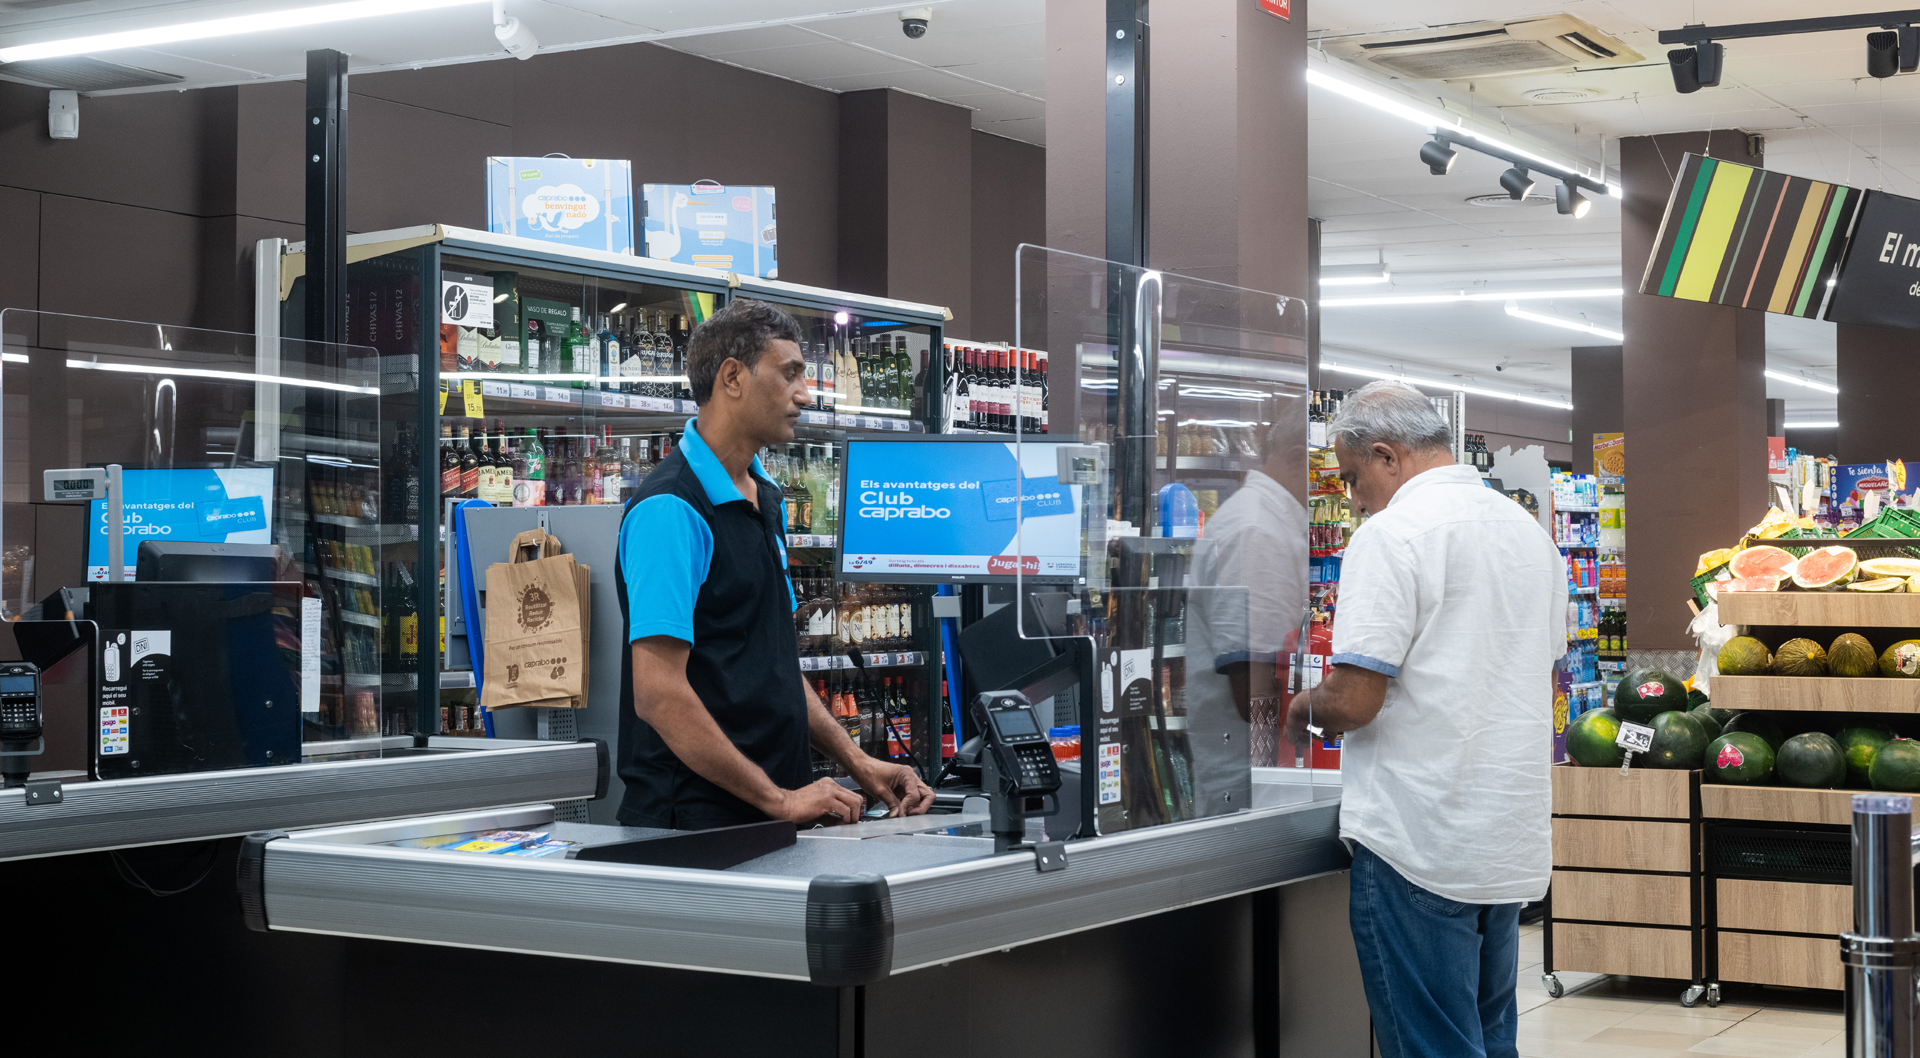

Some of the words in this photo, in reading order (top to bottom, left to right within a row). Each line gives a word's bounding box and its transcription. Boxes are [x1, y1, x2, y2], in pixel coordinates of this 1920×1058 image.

[545, 202, 586, 211] benvingut
[1879, 232, 1903, 264] El
[370, 291, 377, 302] 12
[396, 288, 403, 299] 12
[548, 308, 566, 316] REGALO
[1848, 467, 1856, 476] Te
[1858, 465, 1883, 476] sienta
[860, 480, 880, 488] Els
[882, 481, 956, 491] avantatges
[958, 480, 980, 490] del
[860, 491, 914, 505] Club
[101, 512, 142, 523] Cub
[859, 504, 951, 521] caprabo
[529, 592, 540, 602] 3R
[135, 643, 147, 653] DNI
[524, 659, 550, 668] caprabo
